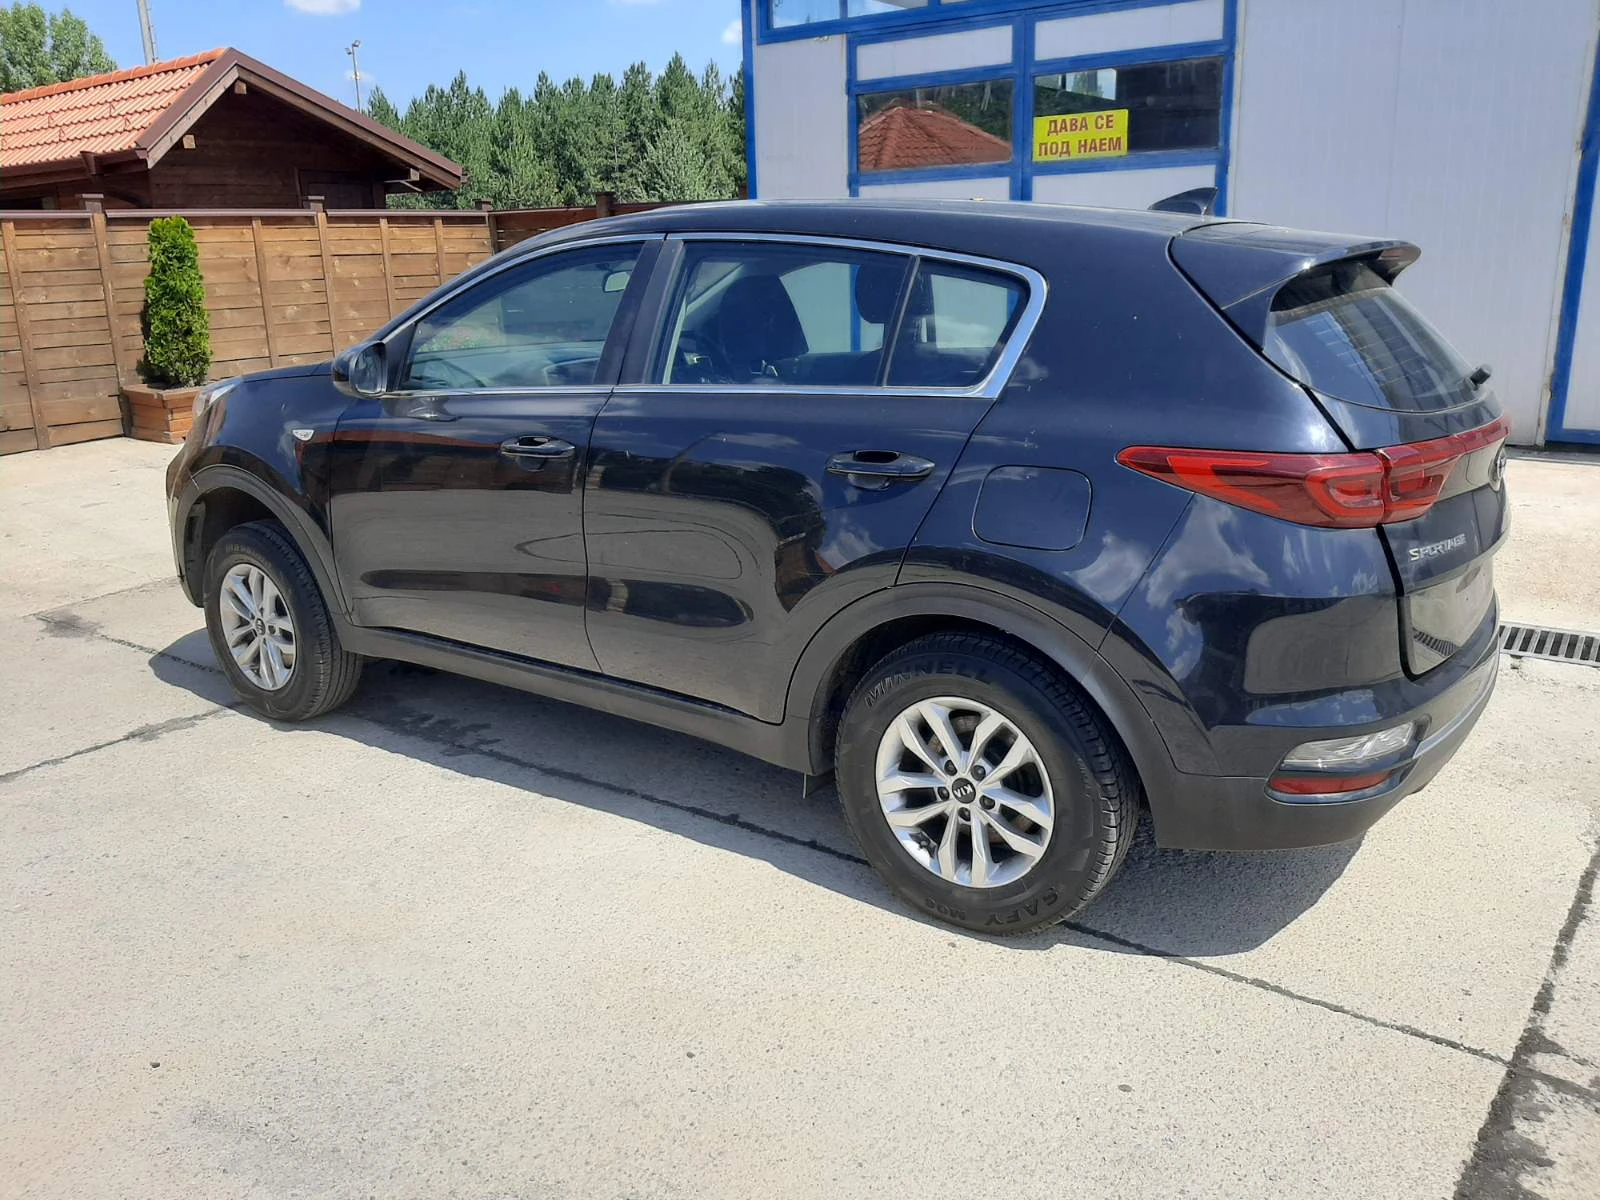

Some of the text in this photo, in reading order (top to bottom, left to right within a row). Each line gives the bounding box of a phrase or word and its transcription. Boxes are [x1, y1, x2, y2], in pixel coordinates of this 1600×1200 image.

[1047, 114, 1115, 136] ДАВА СЕ
[1038, 136, 1122, 157] ПОД НАЕМ
[1408, 533, 1467, 561] SPORTAGE
[953, 783, 974, 798] KIA
